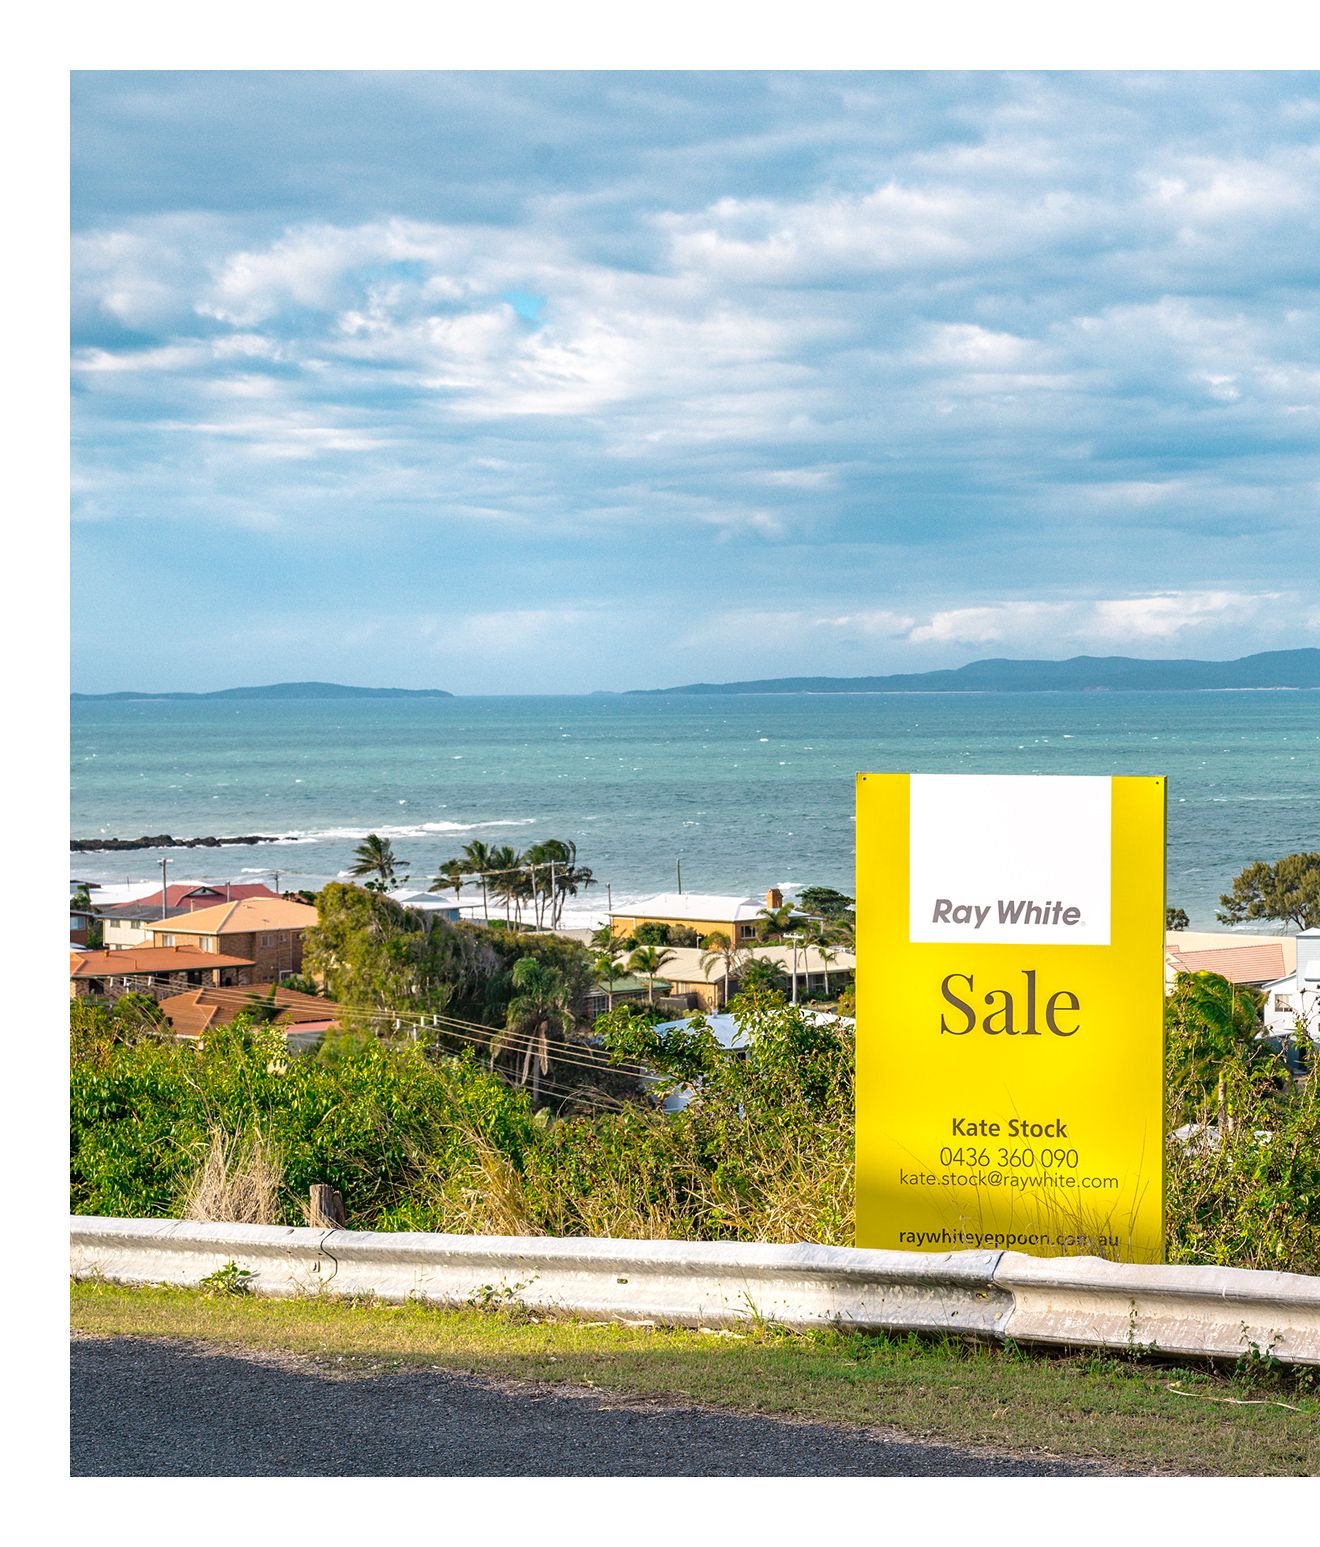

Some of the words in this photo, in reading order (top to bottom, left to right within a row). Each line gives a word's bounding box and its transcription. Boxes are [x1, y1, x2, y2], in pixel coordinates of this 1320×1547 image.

[932, 898, 991, 929] Ray
[997, 899, 1081, 926] White
[940, 969, 1081, 1037] Sale
[952, 1117, 1001, 1137] Kate
[1008, 1118, 1068, 1138] Stock
[940, 1146, 990, 1167] 0436
[997, 1147, 1034, 1168] 360
[1041, 1148, 1079, 1169] 090
[900, 1169, 1119, 1191] kate.stock@raywhite.com
[899, 1228, 1119, 1248] raywhiteyeppoon.comau
